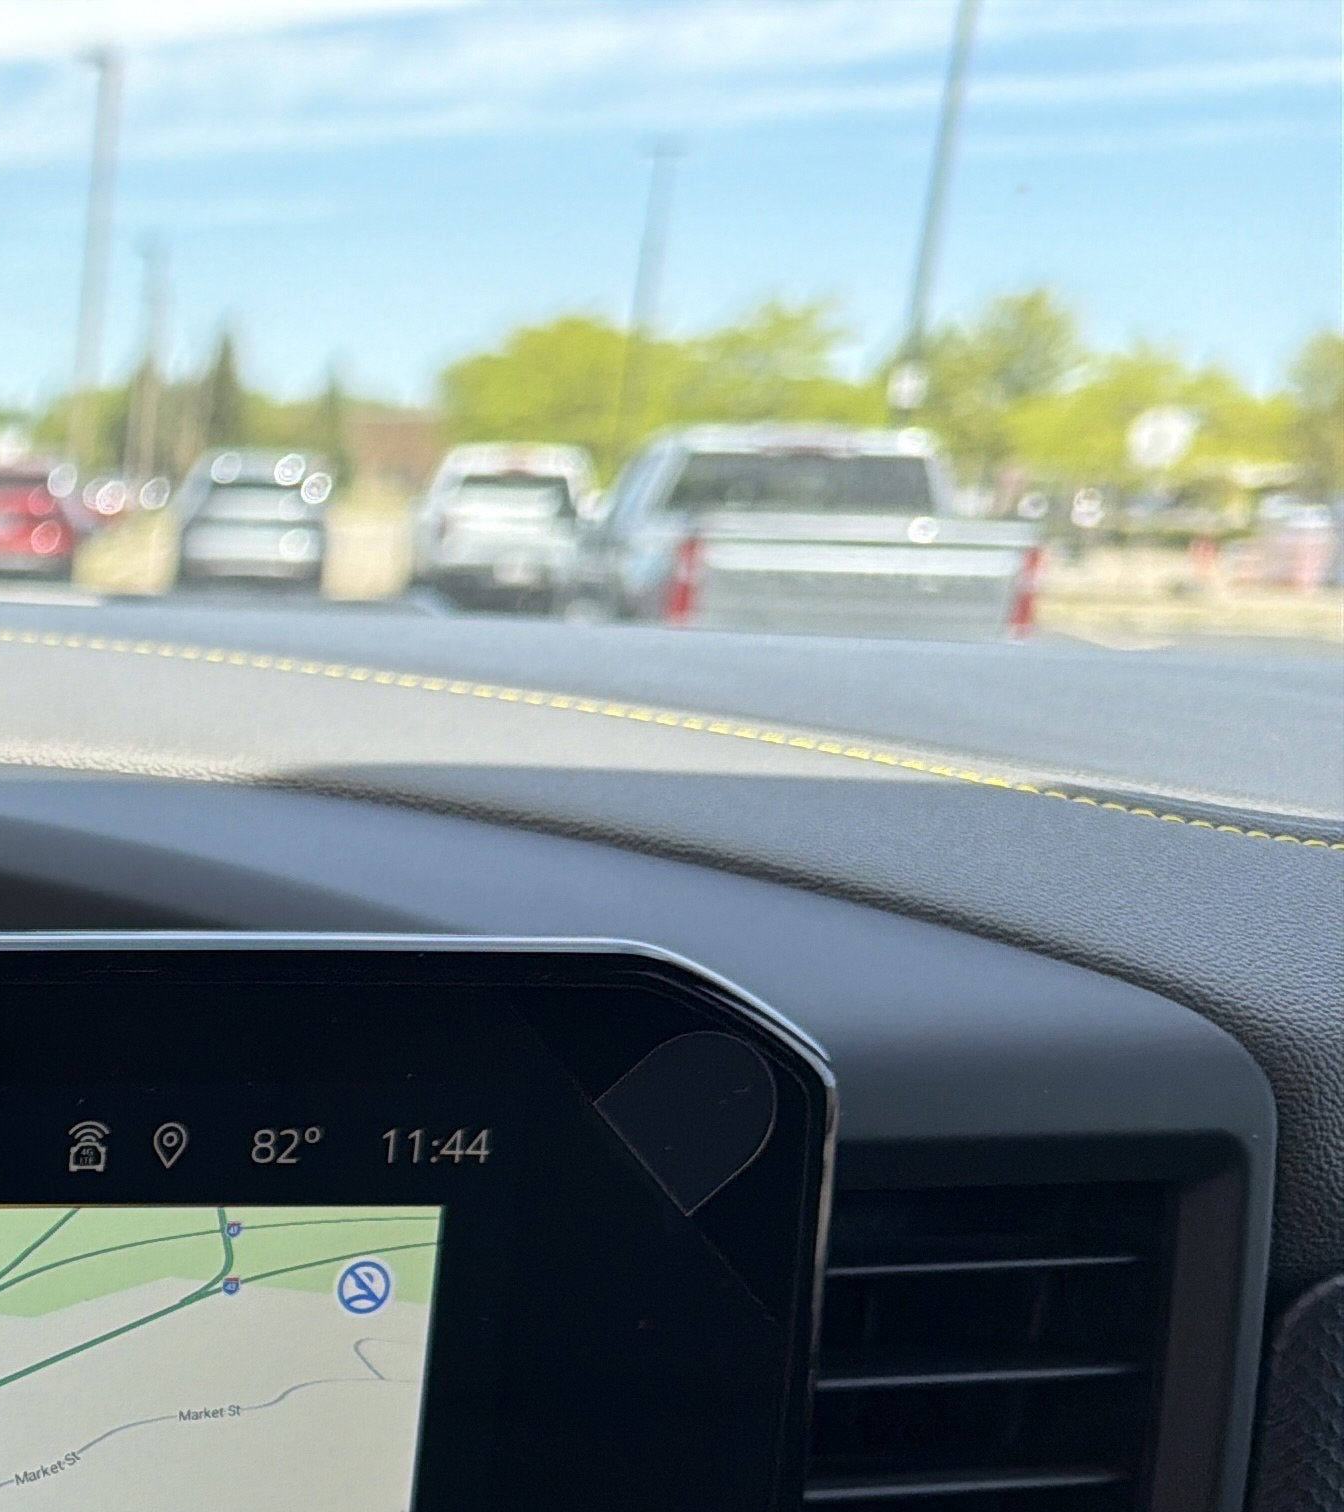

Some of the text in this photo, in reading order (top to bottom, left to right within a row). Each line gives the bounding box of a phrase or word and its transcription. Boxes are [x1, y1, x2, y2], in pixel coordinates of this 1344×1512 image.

[251, 1127, 323, 1164] 82°
[382, 1129, 492, 1164] 11:44
[178, 1403, 241, 1422] Market St
[15, 1450, 80, 1486] Market St
